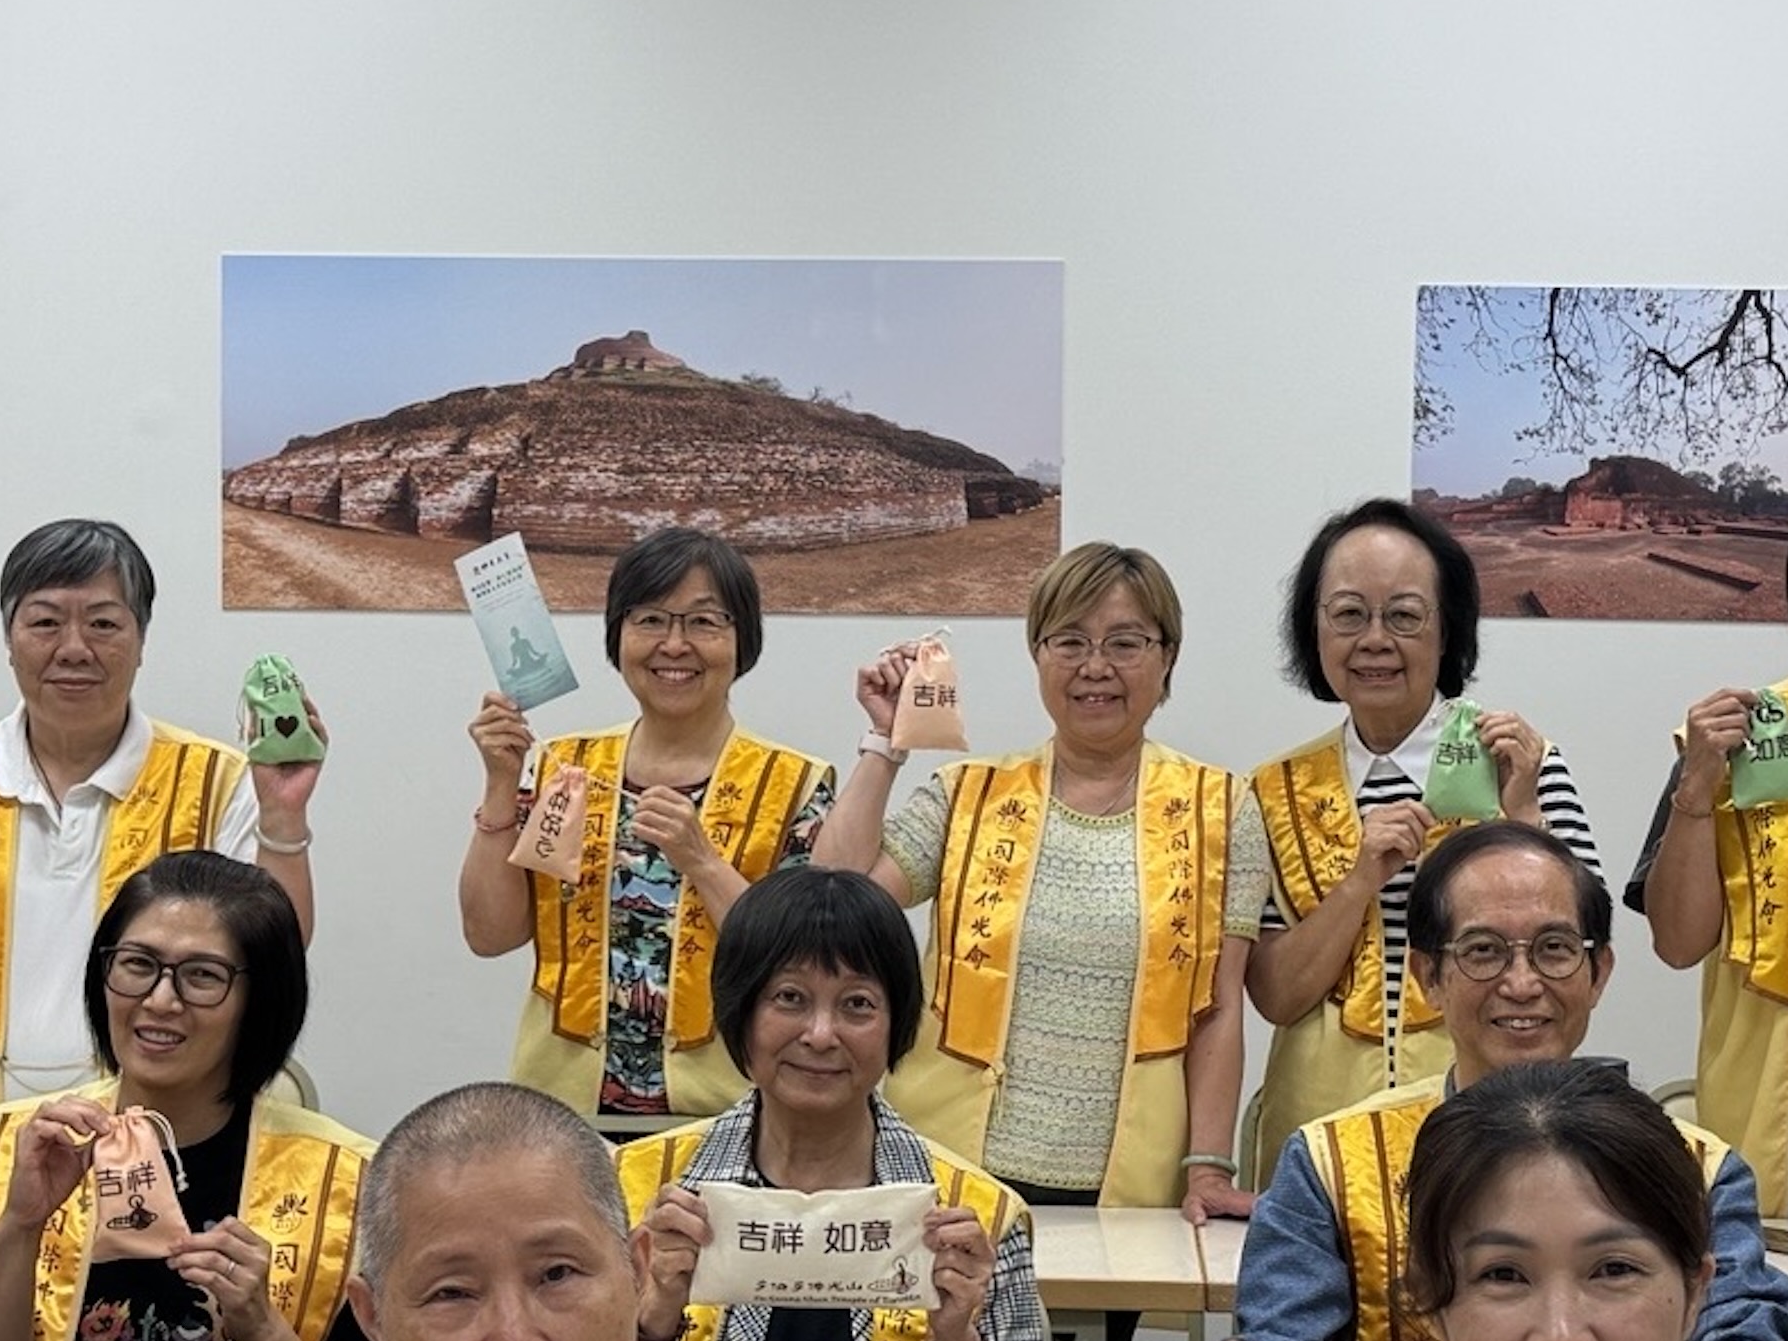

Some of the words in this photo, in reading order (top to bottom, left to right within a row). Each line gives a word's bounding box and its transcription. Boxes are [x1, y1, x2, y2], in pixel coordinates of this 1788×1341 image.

[912, 684, 958, 709] 吉祥
[96, 1161, 157, 1197] 吉祥
[737, 1221, 804, 1254] 吉祥
[824, 1219, 893, 1254] 如意
